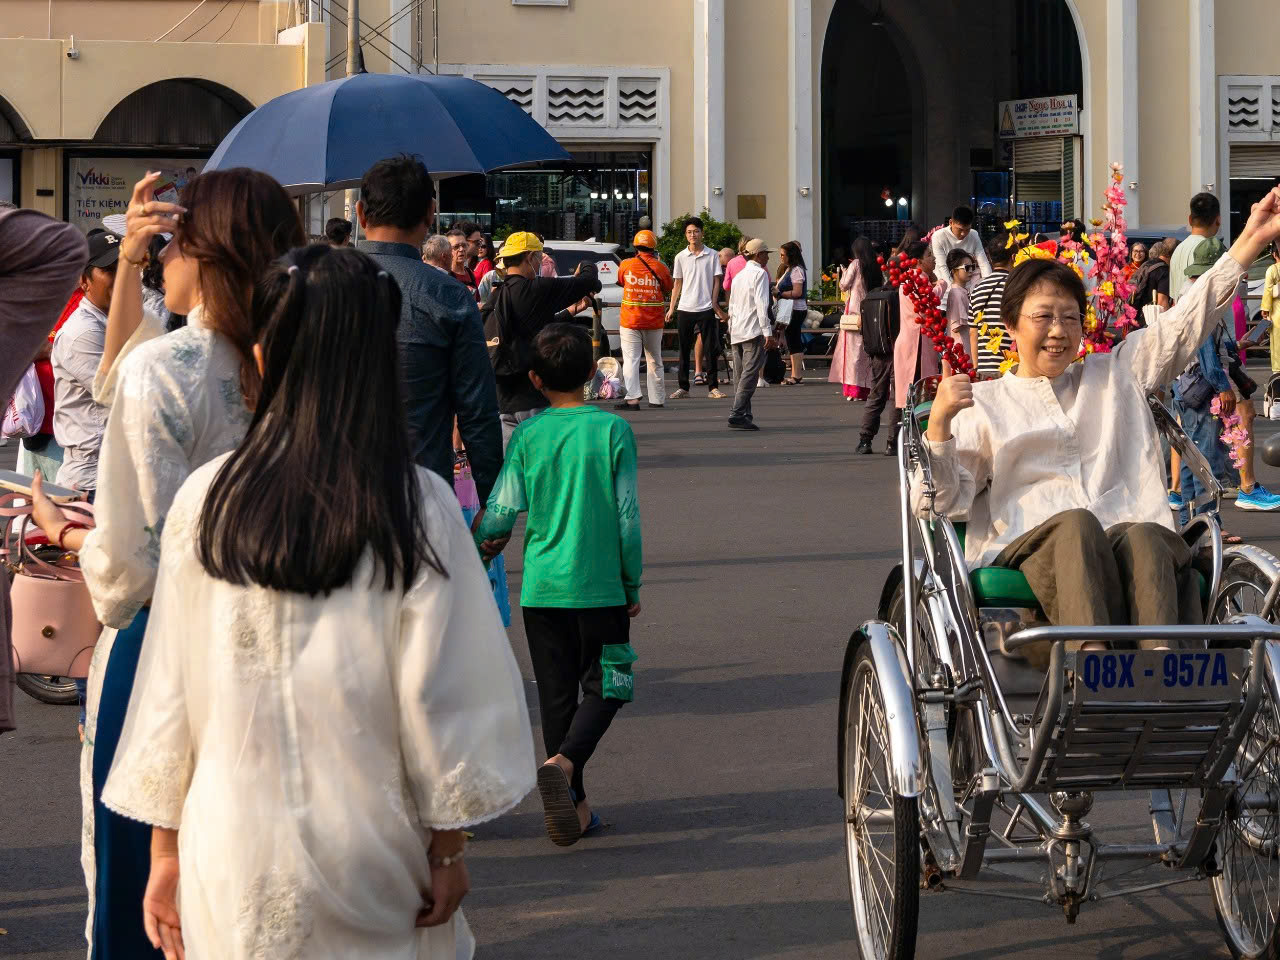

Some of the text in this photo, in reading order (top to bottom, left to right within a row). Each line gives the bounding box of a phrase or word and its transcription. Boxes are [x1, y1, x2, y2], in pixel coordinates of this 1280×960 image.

[76, 167, 110, 186] Vikki
[76, 196, 96, 208] TIẾT
[99, 198, 121, 210] KIỆM
[1163, 653, 1228, 688] 957A
